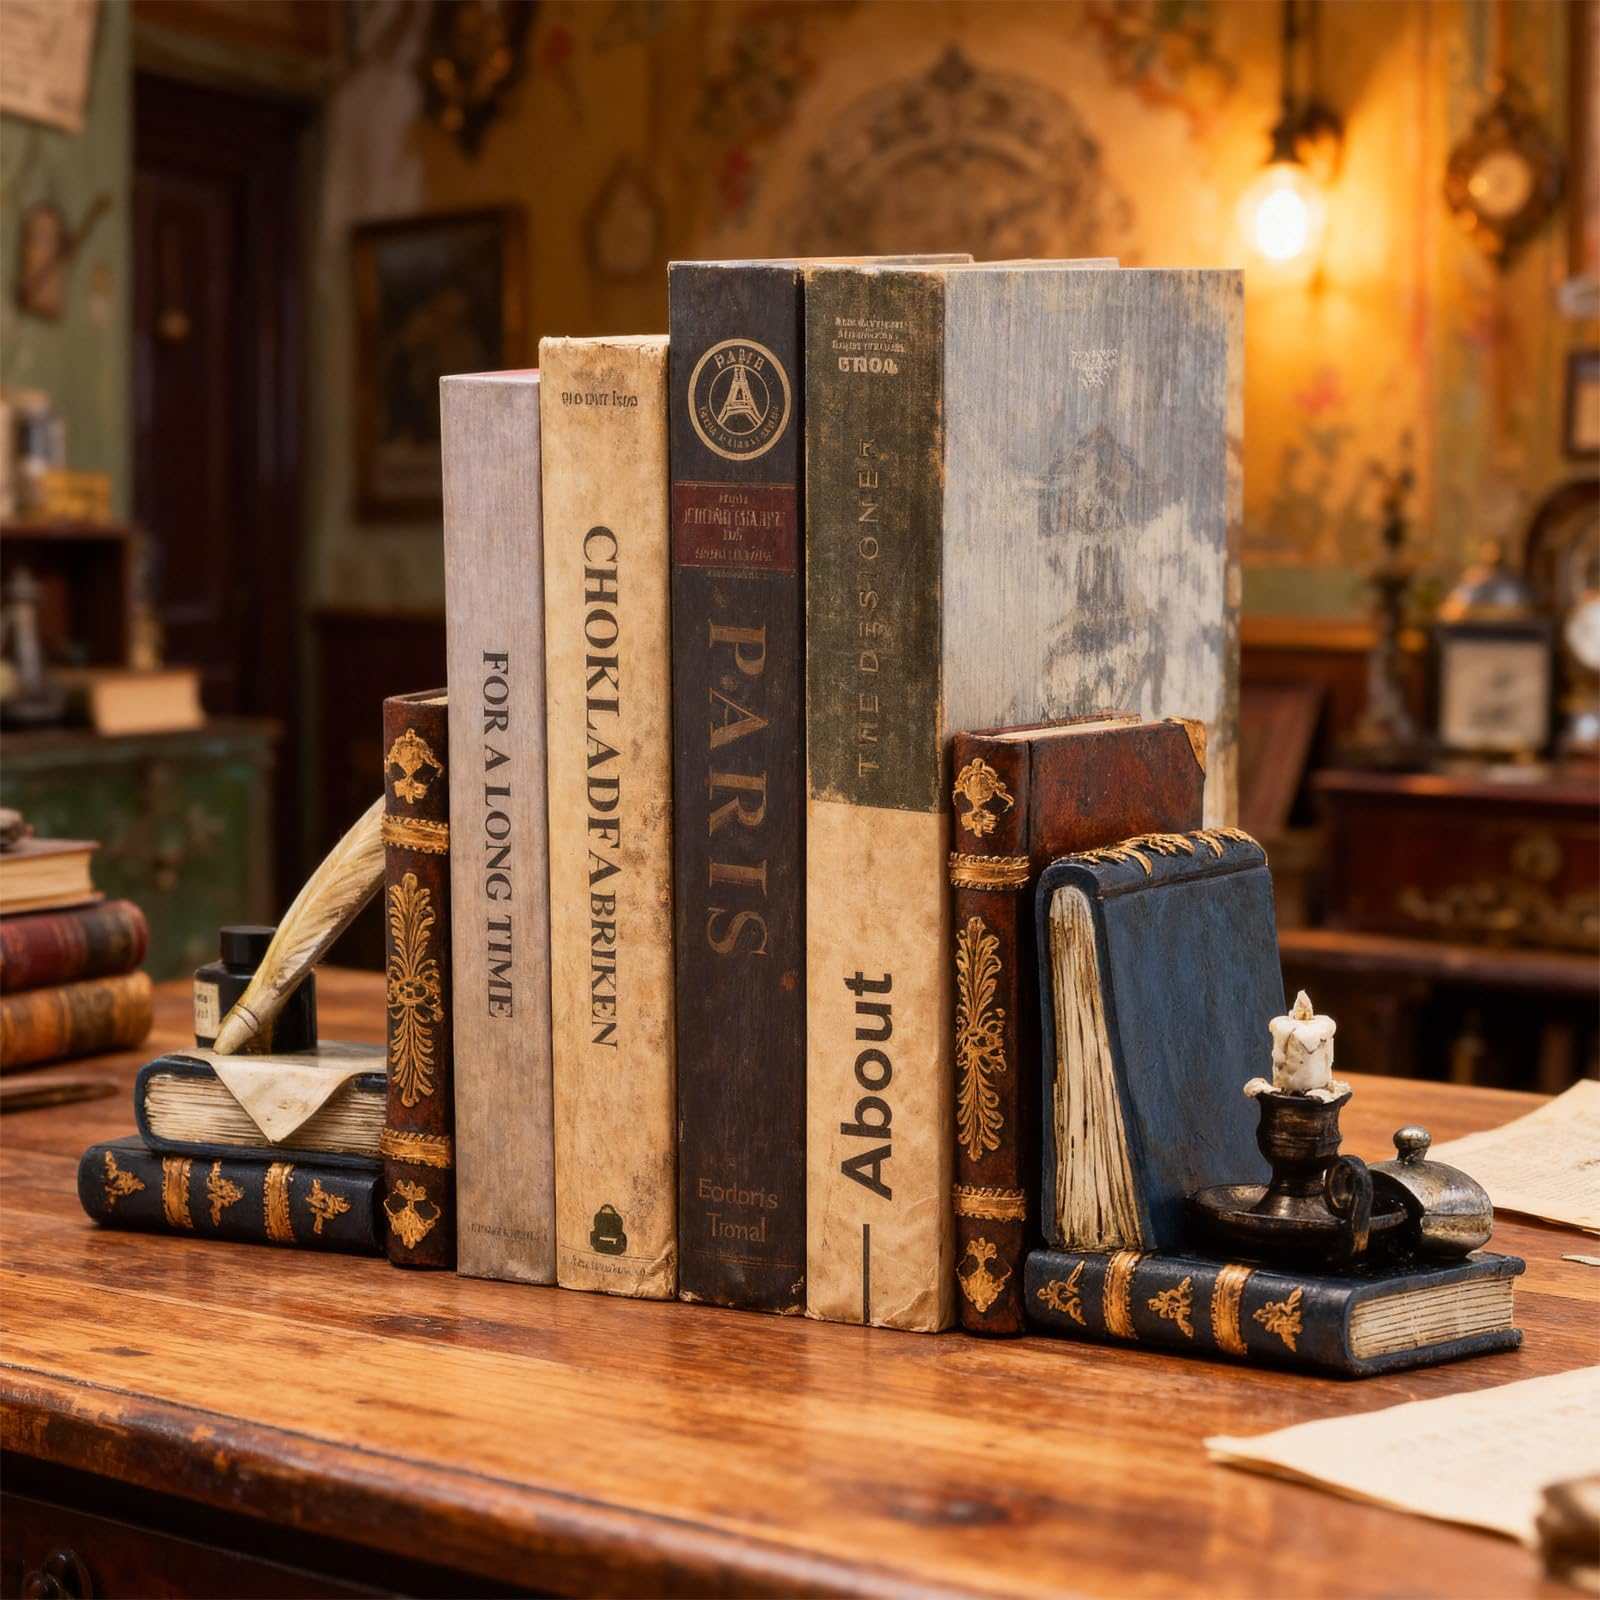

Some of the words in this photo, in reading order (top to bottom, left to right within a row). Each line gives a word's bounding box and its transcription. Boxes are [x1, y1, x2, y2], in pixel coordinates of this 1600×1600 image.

[482, 649, 510, 735] FOR
[484, 743, 512, 773] A
[582, 525, 622, 1051] CHOKLADFABRIKEN
[706, 618, 769, 955] PARIS
[484, 782, 513, 901] LONG
[486, 914, 514, 1019] TIME
[839, 970, 893, 1202] About
